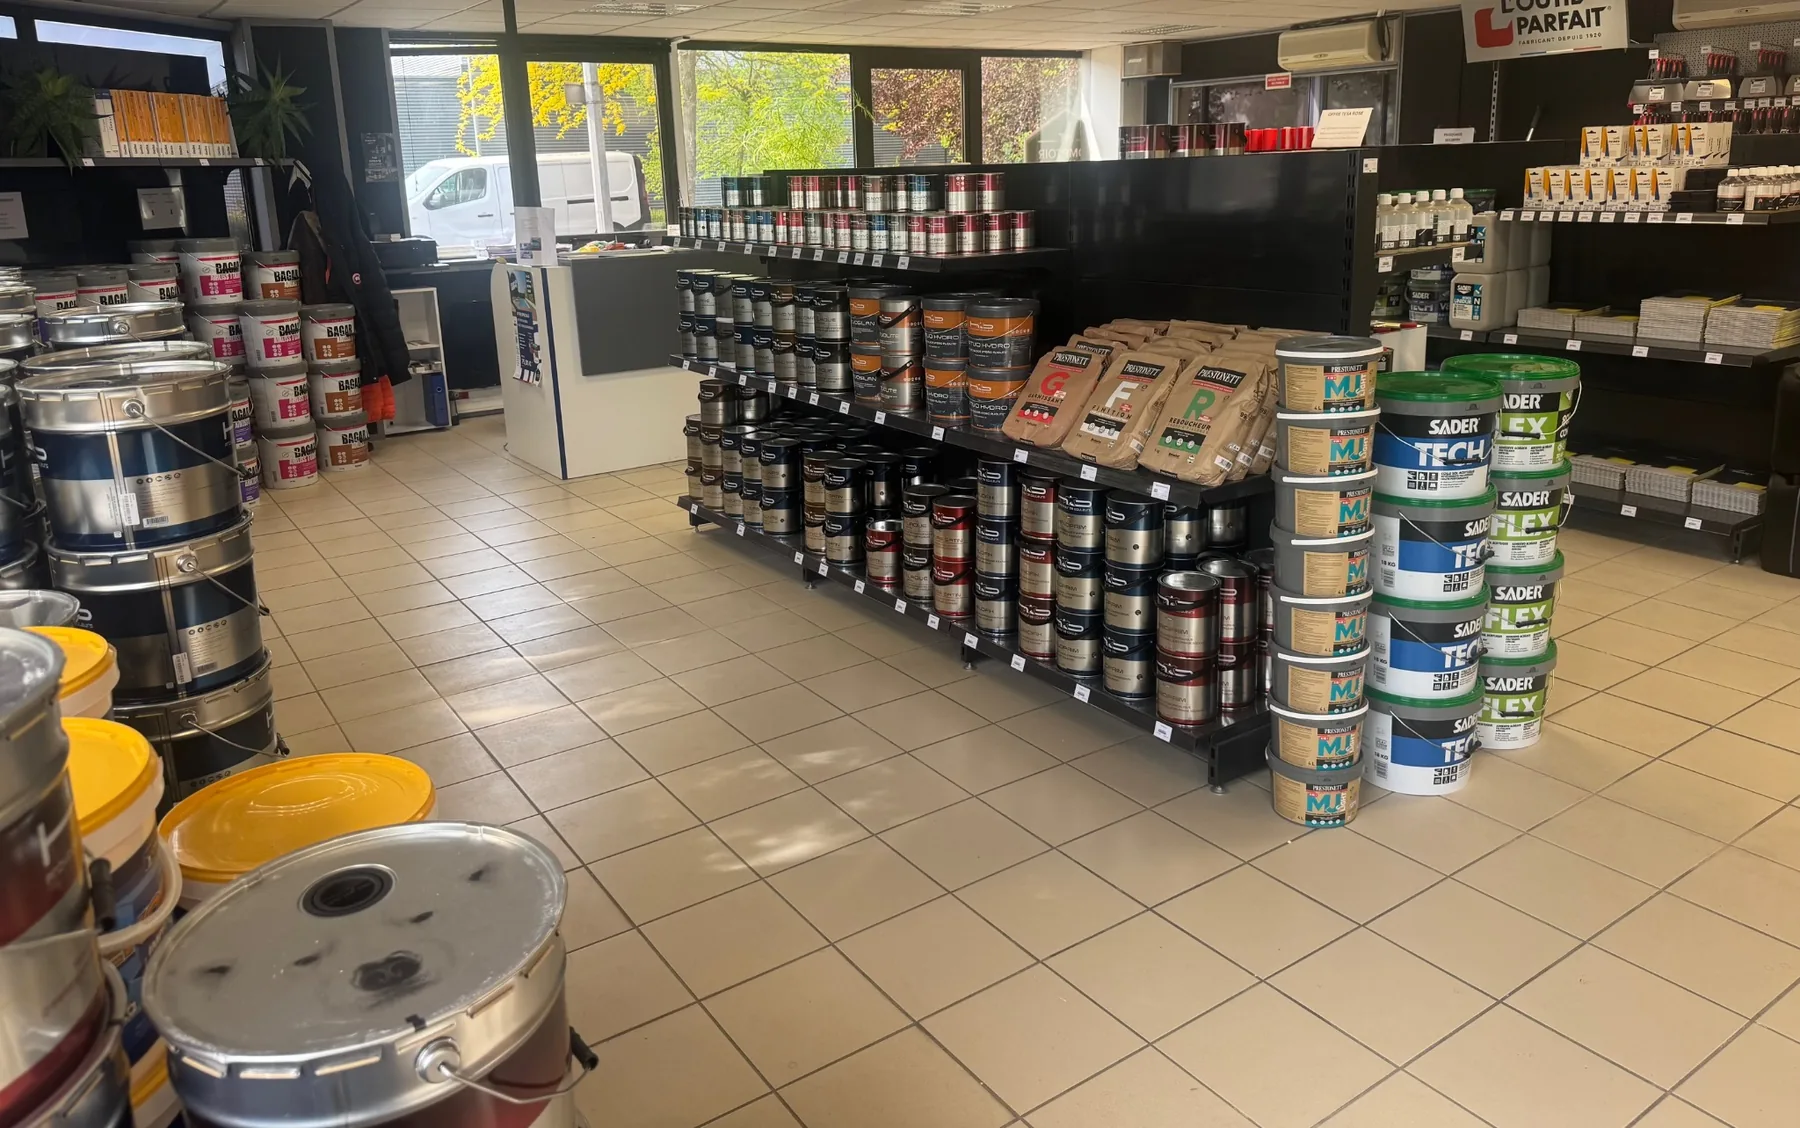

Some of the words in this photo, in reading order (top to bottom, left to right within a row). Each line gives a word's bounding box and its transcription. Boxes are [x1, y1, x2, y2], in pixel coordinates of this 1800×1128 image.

[1516, 6, 1607, 35] PARFAIT
[1518, 37, 1556, 46] FABRICANT
[215, 261, 240, 274] BAGA
[1411, 292, 1430, 300] SADER
[278, 322, 300, 336] BAGA
[1053, 352, 1090, 366] PRESTONETT
[1124, 363, 1161, 377] PRESTONETT
[1198, 368, 1242, 385] PRESTONETT
[1331, 364, 1363, 373] PRESTONETT
[338, 377, 360, 391] BAGA
[1041, 371, 1071, 396] G
[1027, 393, 1064, 404] GARNISSANT
[1105, 381, 1139, 408] F
[1503, 394, 1541, 410] ADER
[1092, 404, 1133, 420] FINITION
[1183, 388, 1216, 420] R
[1168, 417, 1211, 431] REBOUCHEUR
[1337, 427, 1366, 436] PRESTONETT
[1428, 417, 1480, 435] SADER
[294, 443, 316, 458] BAGA
[1414, 439, 1485, 467] TECH
[1346, 487, 1369, 498] PRESTONETT
[1501, 491, 1550, 507] SADER
[1491, 511, 1554, 537] FLEX
[1451, 539, 1488, 569] TEC
[1495, 585, 1544, 601] SADER
[1485, 604, 1547, 630] FLEX
[1453, 617, 1482, 639] SADE
[1441, 639, 1480, 669] TEC
[1485, 676, 1535, 692] SADER
[1478, 695, 1538, 720] FLEX
[1324, 726, 1352, 734] PRESTONETT
[1452, 713, 1478, 734] SADE
[1441, 734, 1476, 763] TEC
